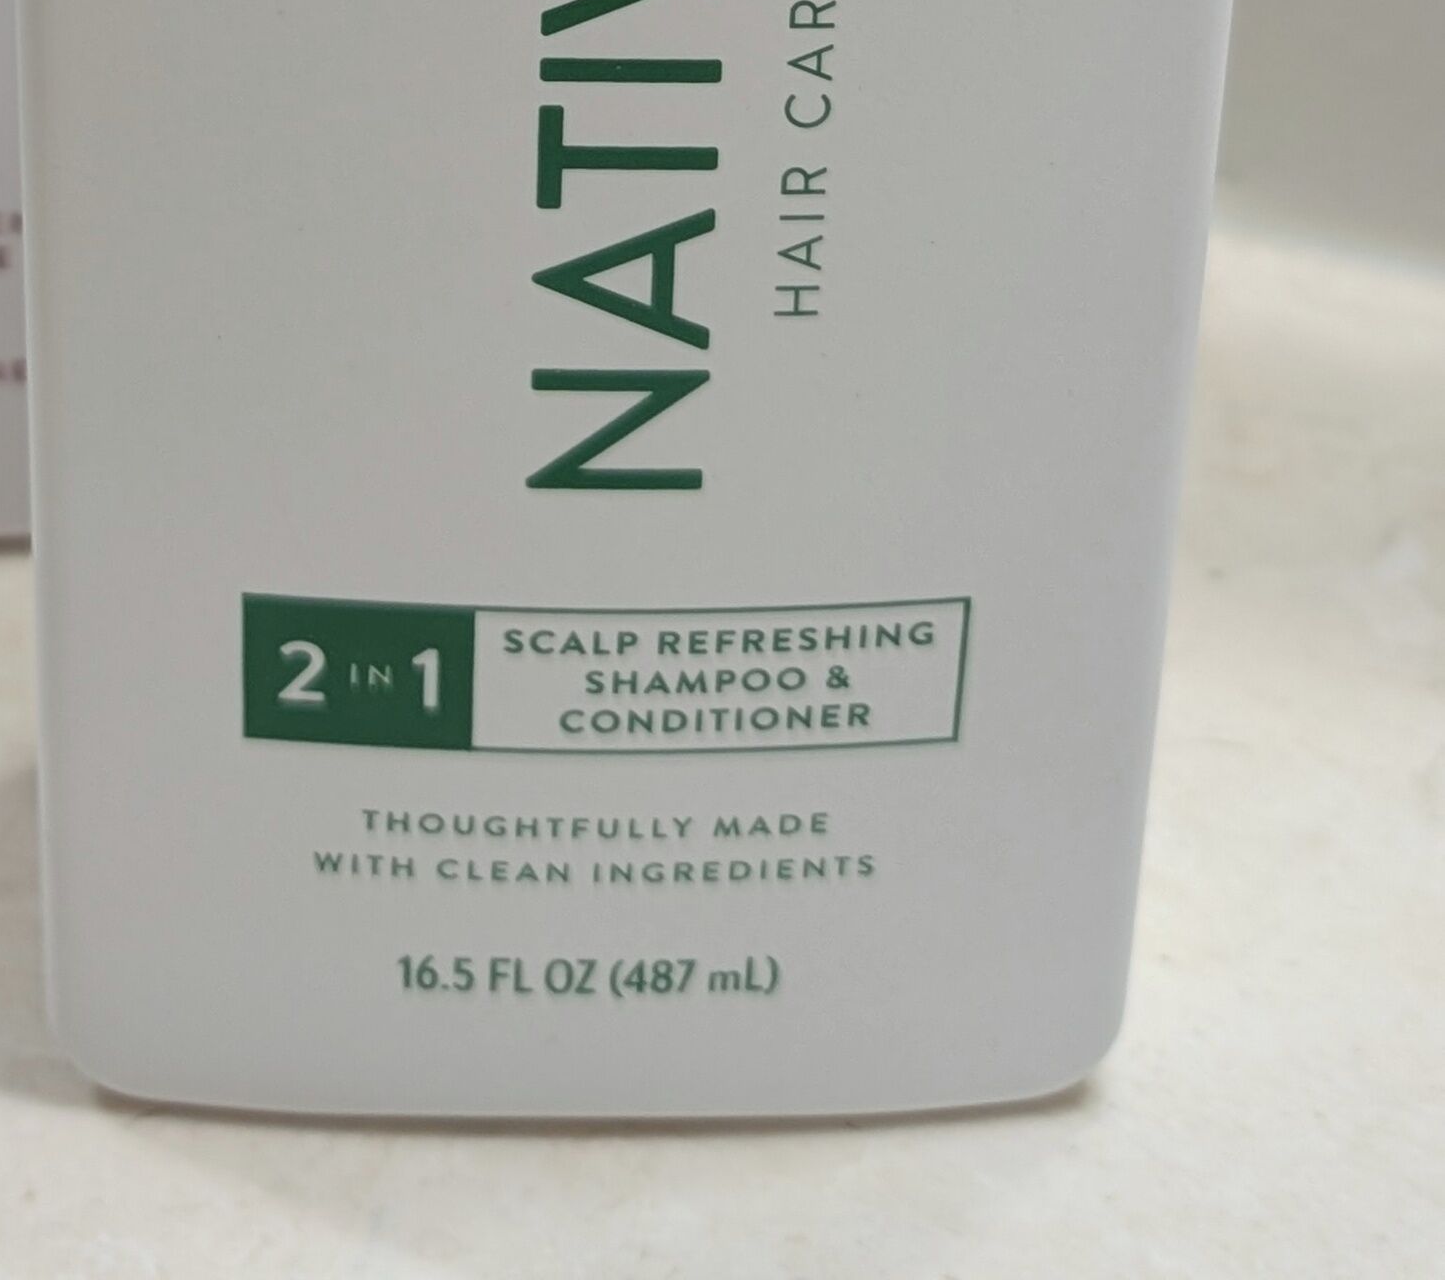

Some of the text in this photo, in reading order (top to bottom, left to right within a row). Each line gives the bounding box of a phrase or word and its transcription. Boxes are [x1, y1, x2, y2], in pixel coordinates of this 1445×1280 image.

[773, 166, 828, 317] HAIR
[503, 621, 934, 657] SCALP REFRESHING
[277, 639, 440, 709] 2 IN 1
[585, 665, 850, 696] SHAMPOO &
[559, 702, 871, 735] CONDITIONER
[361, 808, 829, 841] THOUGHTFULLY MADE
[313, 851, 875, 885] WITH CLEAN INGREDIENTS
[397, 954, 781, 999] 16.5 FL OZ (487 mL)
